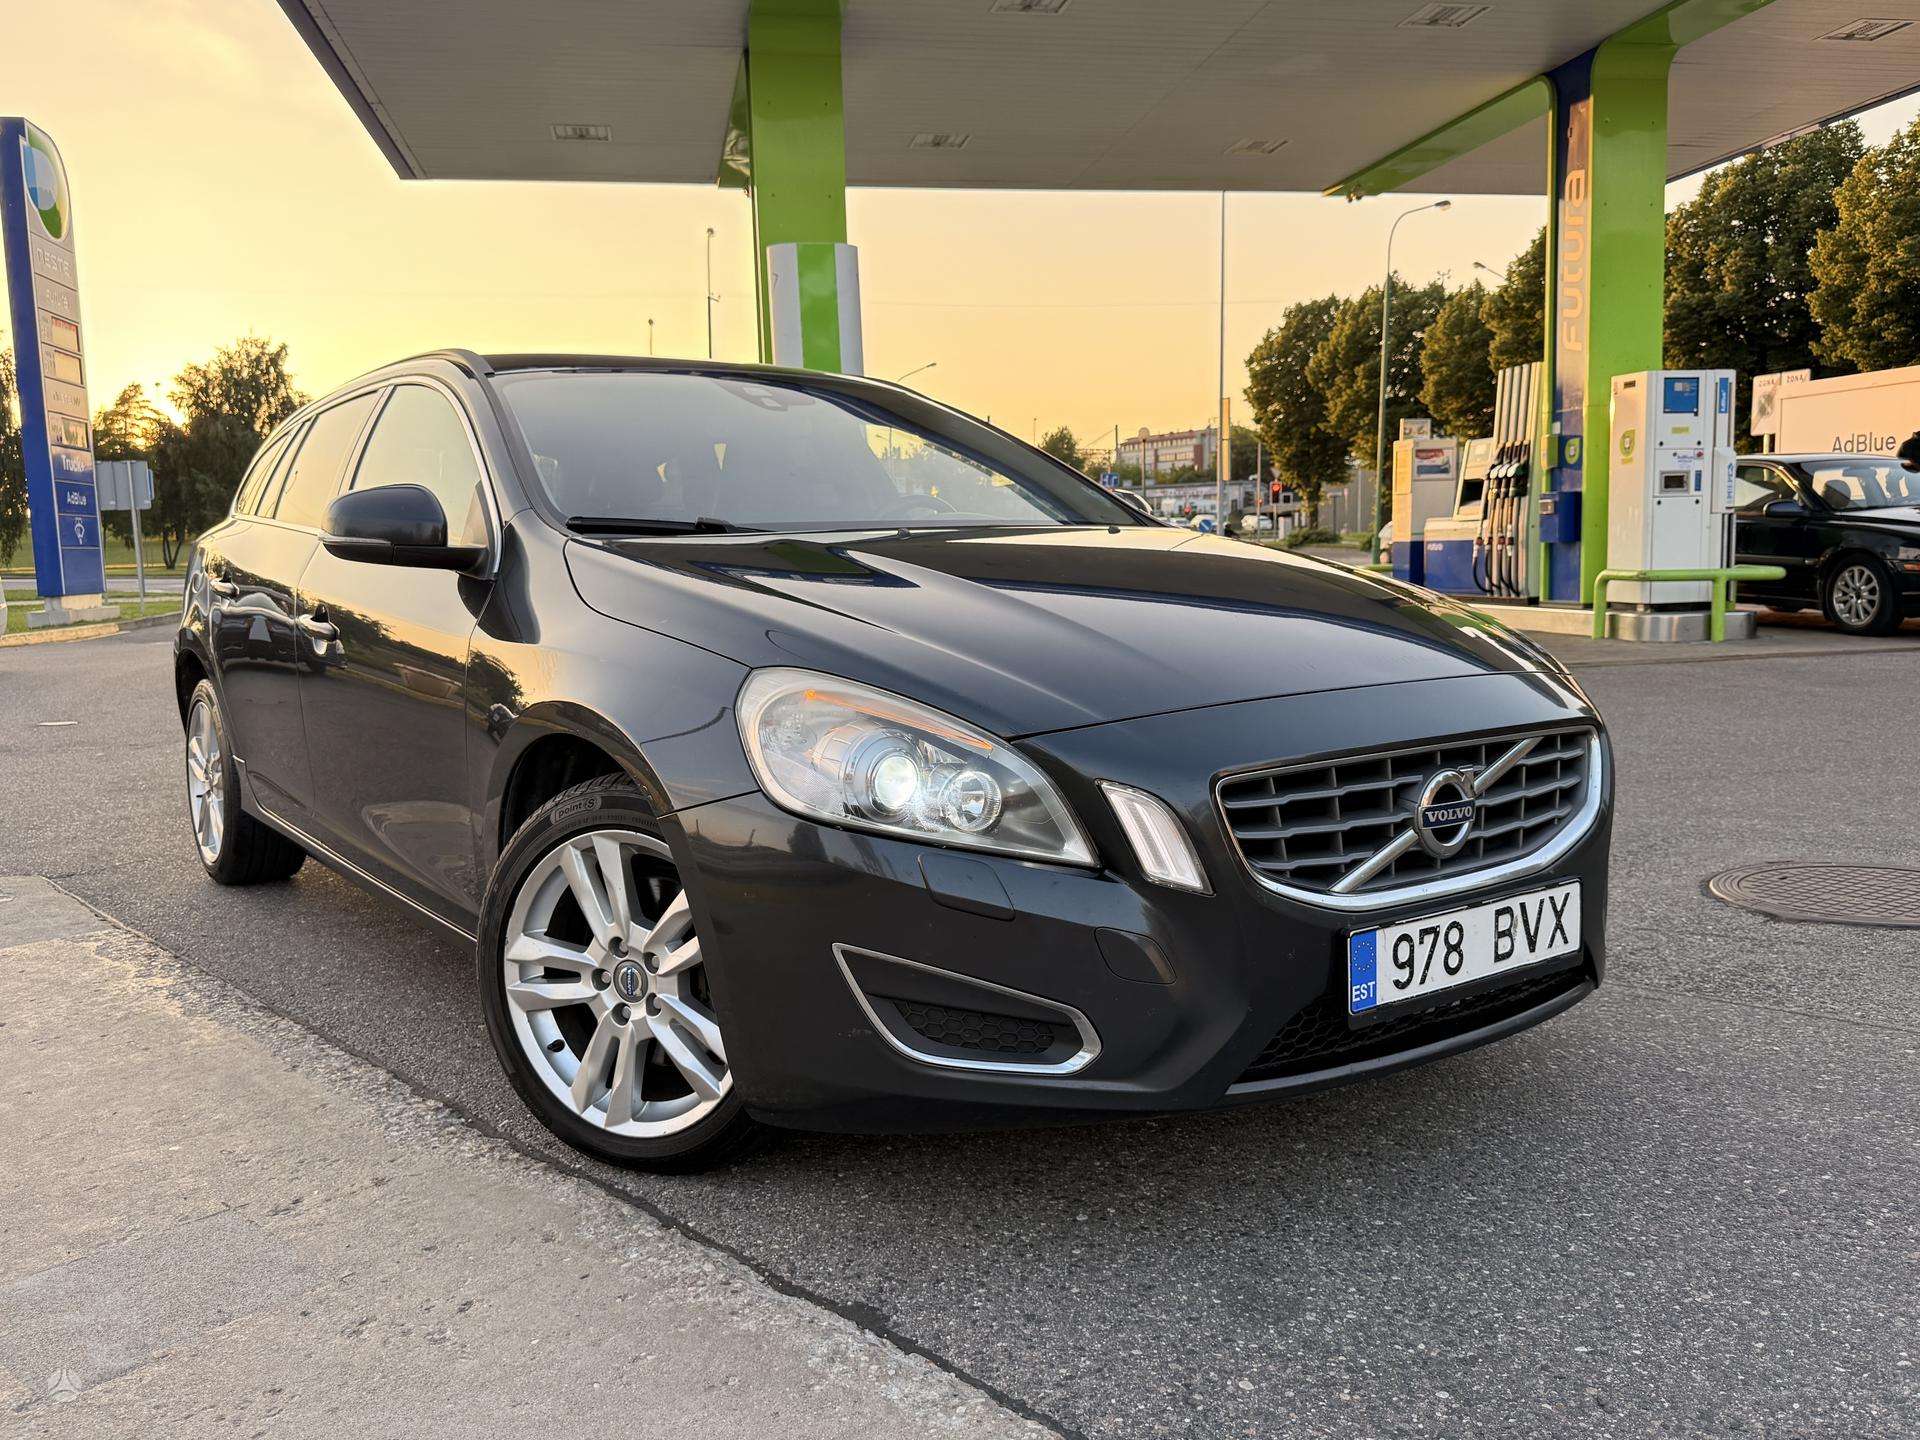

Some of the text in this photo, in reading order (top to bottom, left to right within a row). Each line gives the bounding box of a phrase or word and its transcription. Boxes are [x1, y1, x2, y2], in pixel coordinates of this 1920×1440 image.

[1831, 431, 1897, 453] AdBlue
[66, 490, 87, 506] AdBlue
[1425, 805, 1473, 823] VOLVO
[1392, 892, 1571, 990] 978 BVX
[1352, 980, 1376, 1002] EST
